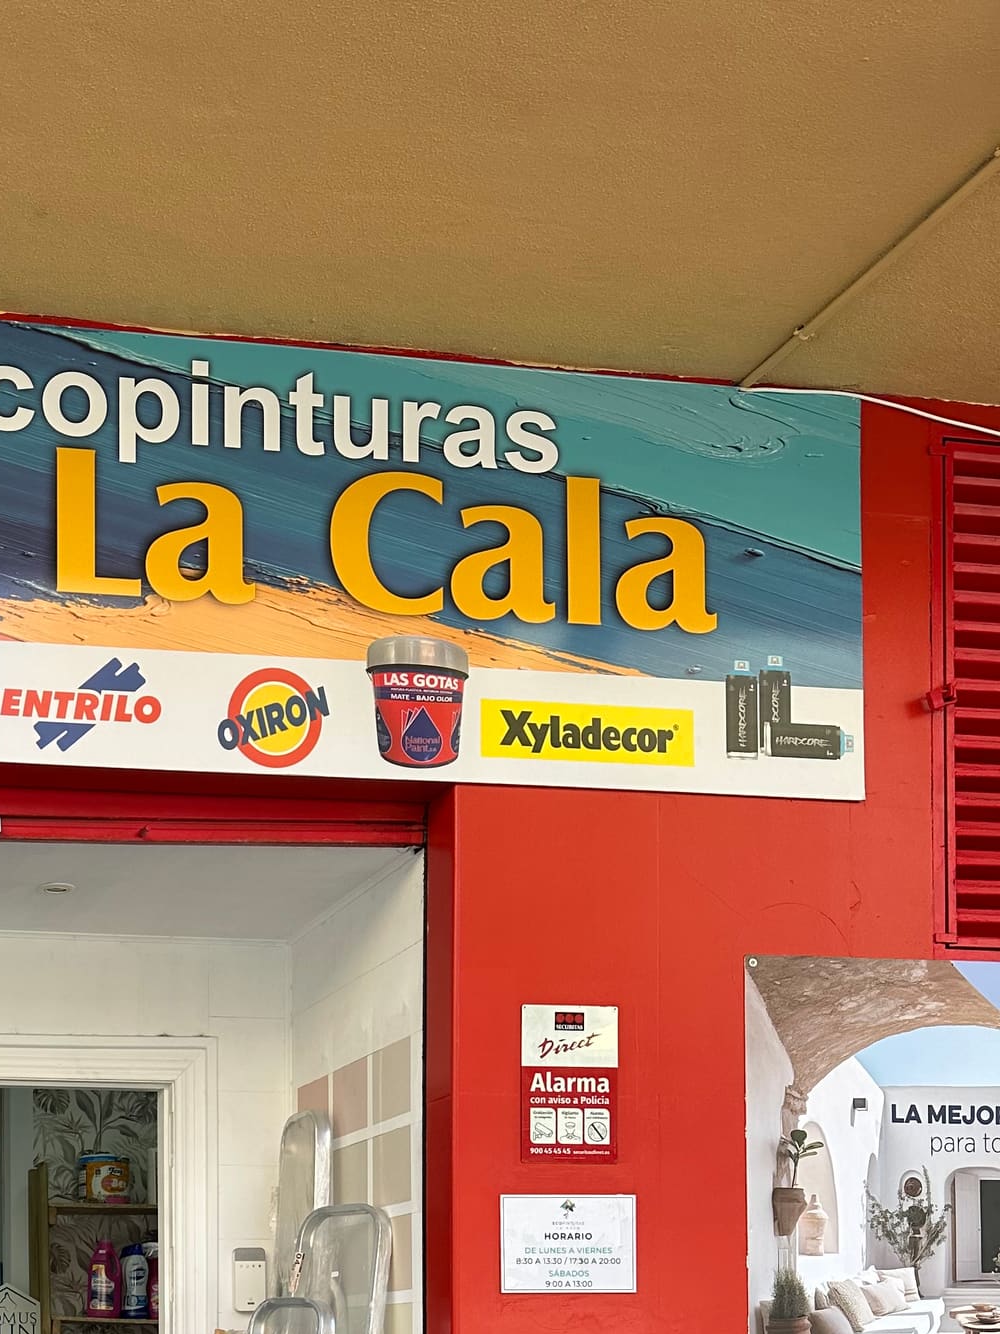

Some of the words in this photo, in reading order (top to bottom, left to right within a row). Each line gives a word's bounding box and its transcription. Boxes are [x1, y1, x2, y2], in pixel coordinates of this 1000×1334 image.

[55, 446, 257, 606] La
[329, 470, 719, 636] Cala
[383, 673, 409, 687] LAS
[413, 674, 459, 690] GOTAS
[390, 693, 410, 701] MATE
[217, 686, 330, 752] OXIRON
[738, 685, 747, 748] HARDCORE
[405, 736, 441, 745] National
[775, 735, 833, 748] HARDCORE
[538, 1032, 603, 1059] Direct
[530, 1072, 610, 1093] Alarma
[530, 1096, 546, 1104] con
[548, 1095, 571, 1104] aviso
[891, 1103, 922, 1124] LA
[530, 1147, 543, 1155] 900
[930, 1136, 976, 1157] para
[544, 1232, 593, 1241] HORARIO
[577, 1247, 613, 1255] VIERNES
[565, 1280, 571, 1288] A
[573, 1280, 593, 1288] 13:00
